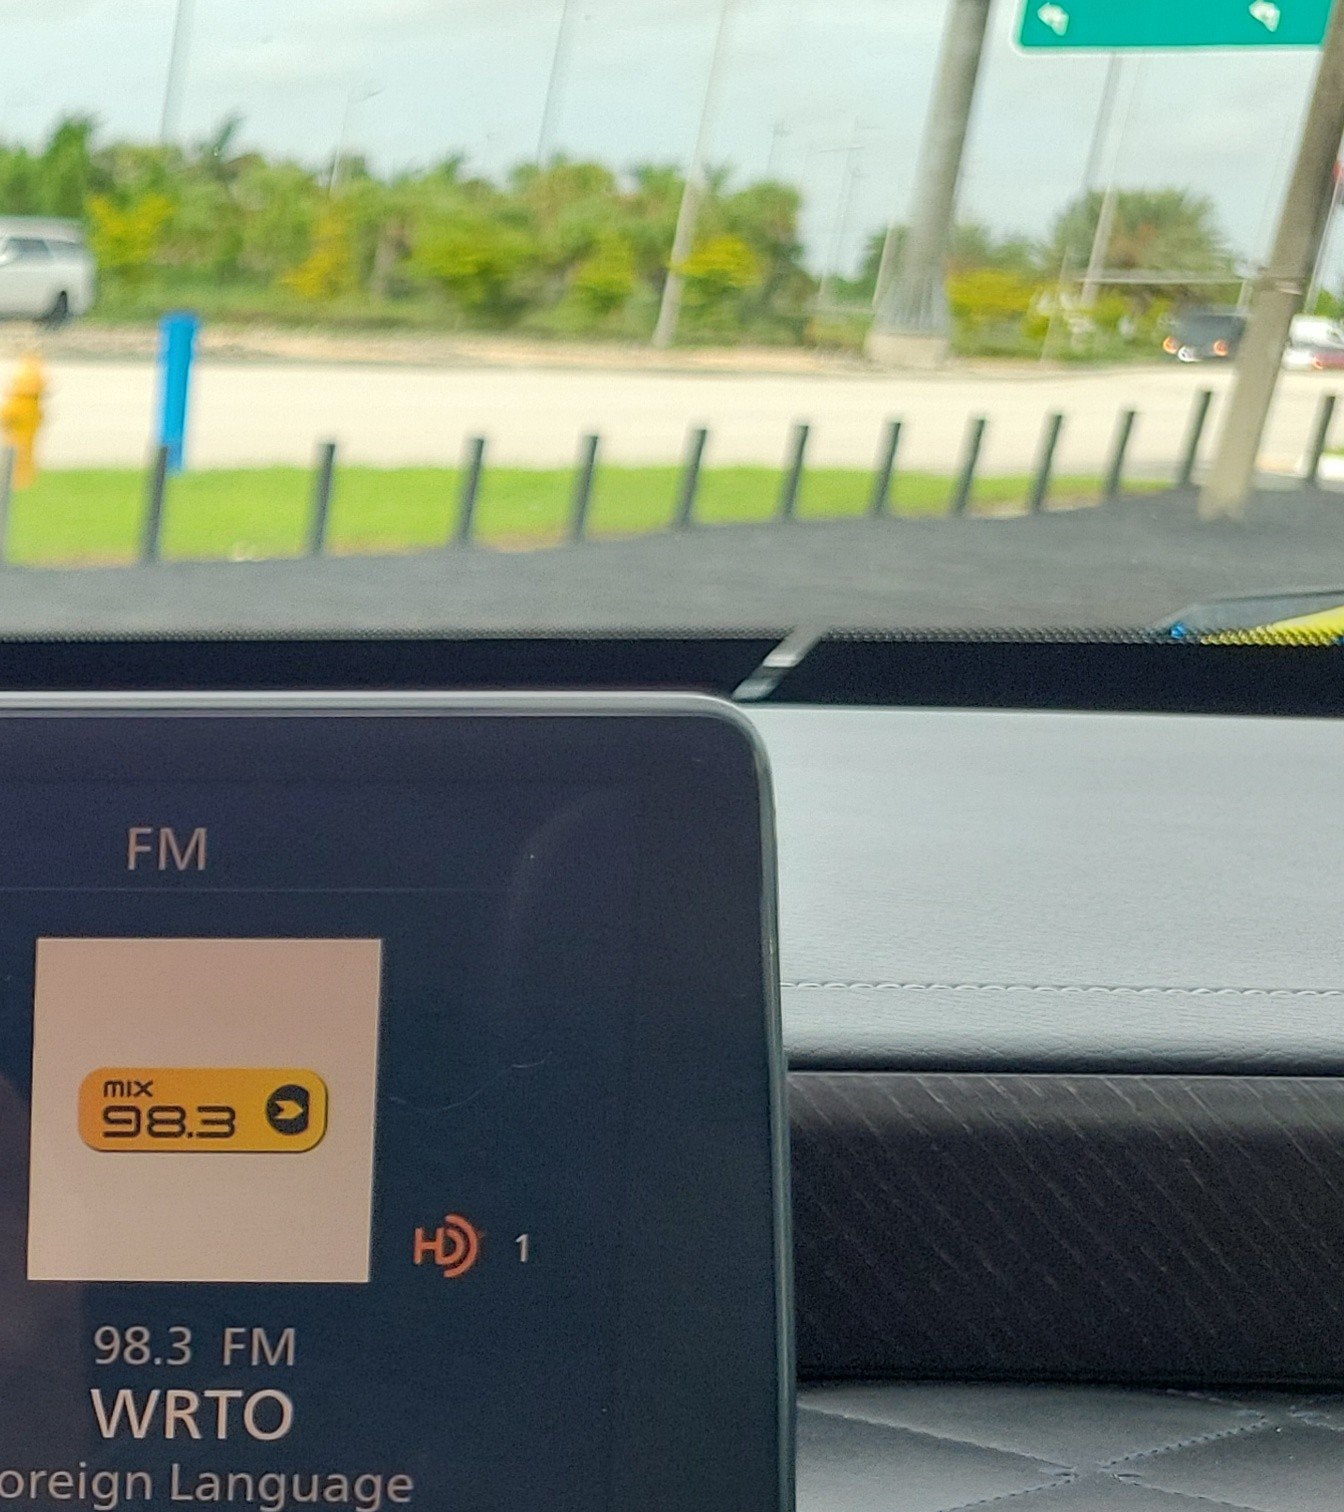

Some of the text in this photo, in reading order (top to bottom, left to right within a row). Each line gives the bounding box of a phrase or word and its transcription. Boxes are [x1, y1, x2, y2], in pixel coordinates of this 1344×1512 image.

[125, 827, 210, 872] FM
[103, 1080, 154, 1098] mix
[102, 1105, 237, 1139] 98.3
[515, 1234, 529, 1262] 1
[92, 1327, 296, 1367] 98.3 FM
[91, 1388, 294, 1441] WRTO
[170, 1463, 414, 1512] Language
